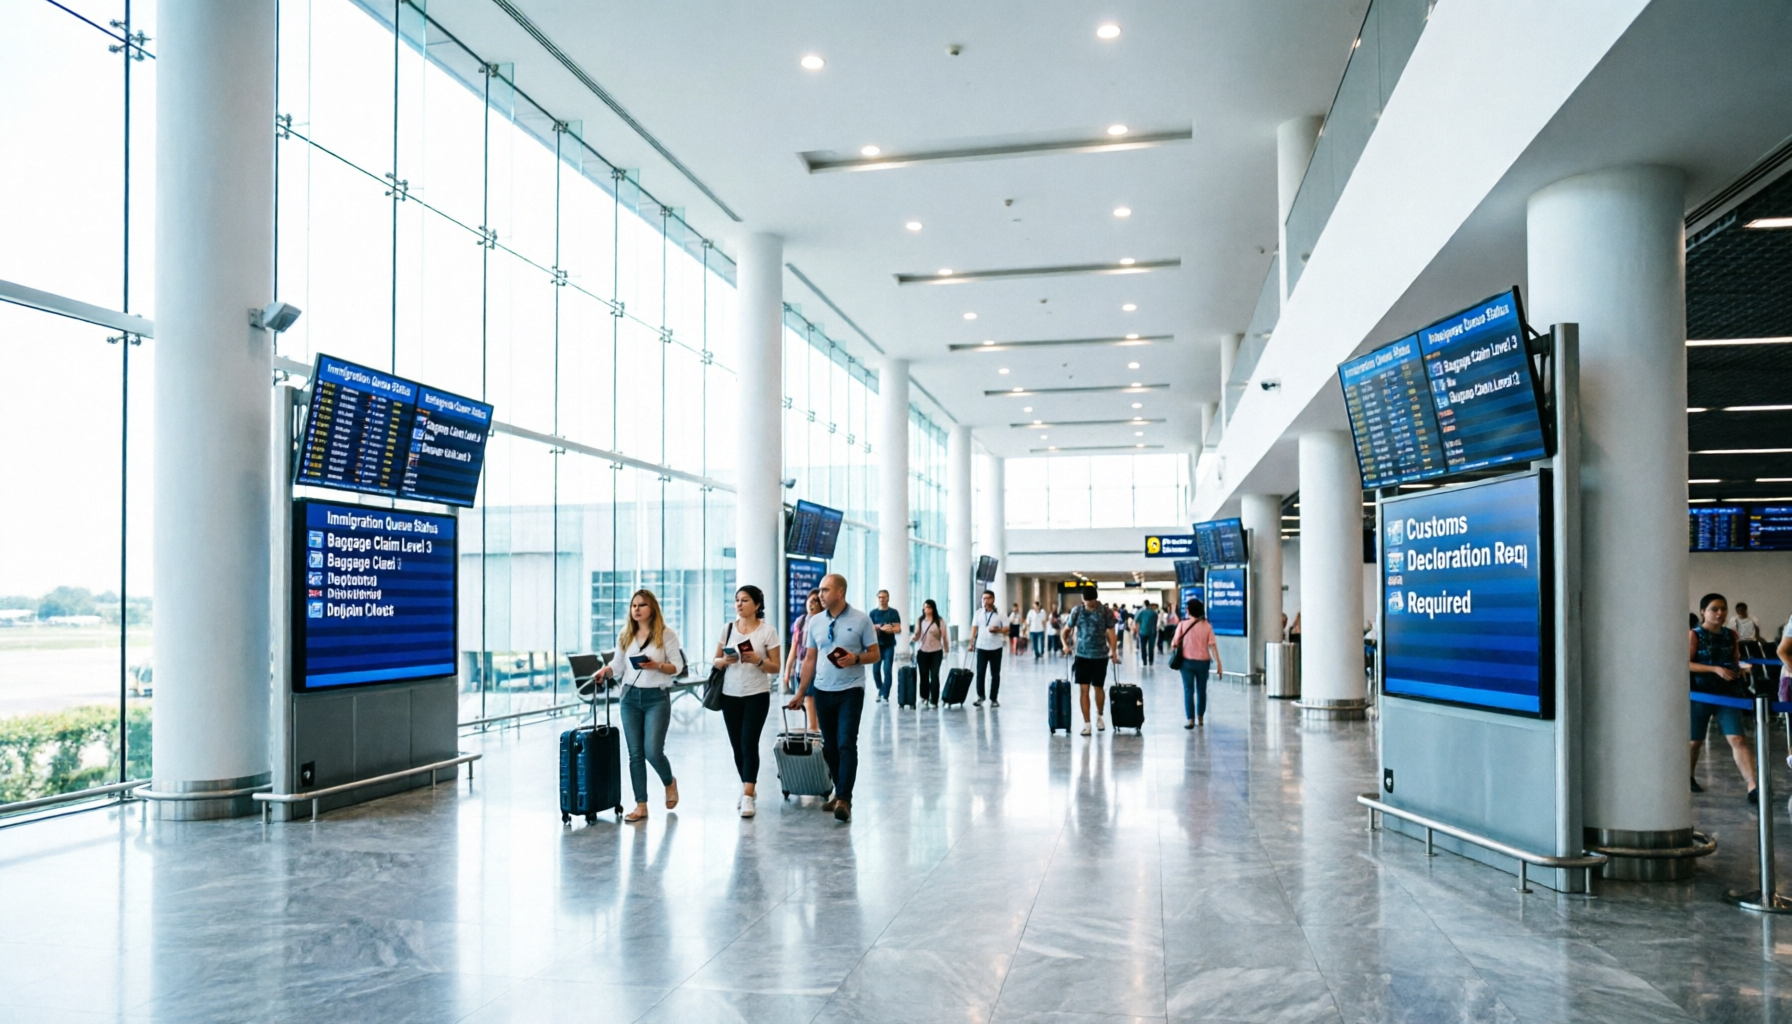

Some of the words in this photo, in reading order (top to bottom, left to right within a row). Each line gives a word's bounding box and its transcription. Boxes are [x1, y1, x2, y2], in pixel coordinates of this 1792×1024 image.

[327, 510, 384, 530] Immigration
[1406, 515, 1468, 540] Customs
[327, 532, 372, 552] Baggage
[373, 535, 400, 552] Claim
[401, 537, 425, 553] Level
[426, 540, 433, 554] 3
[327, 552, 371, 572] Baggage
[1407, 589, 1472, 620] Required
